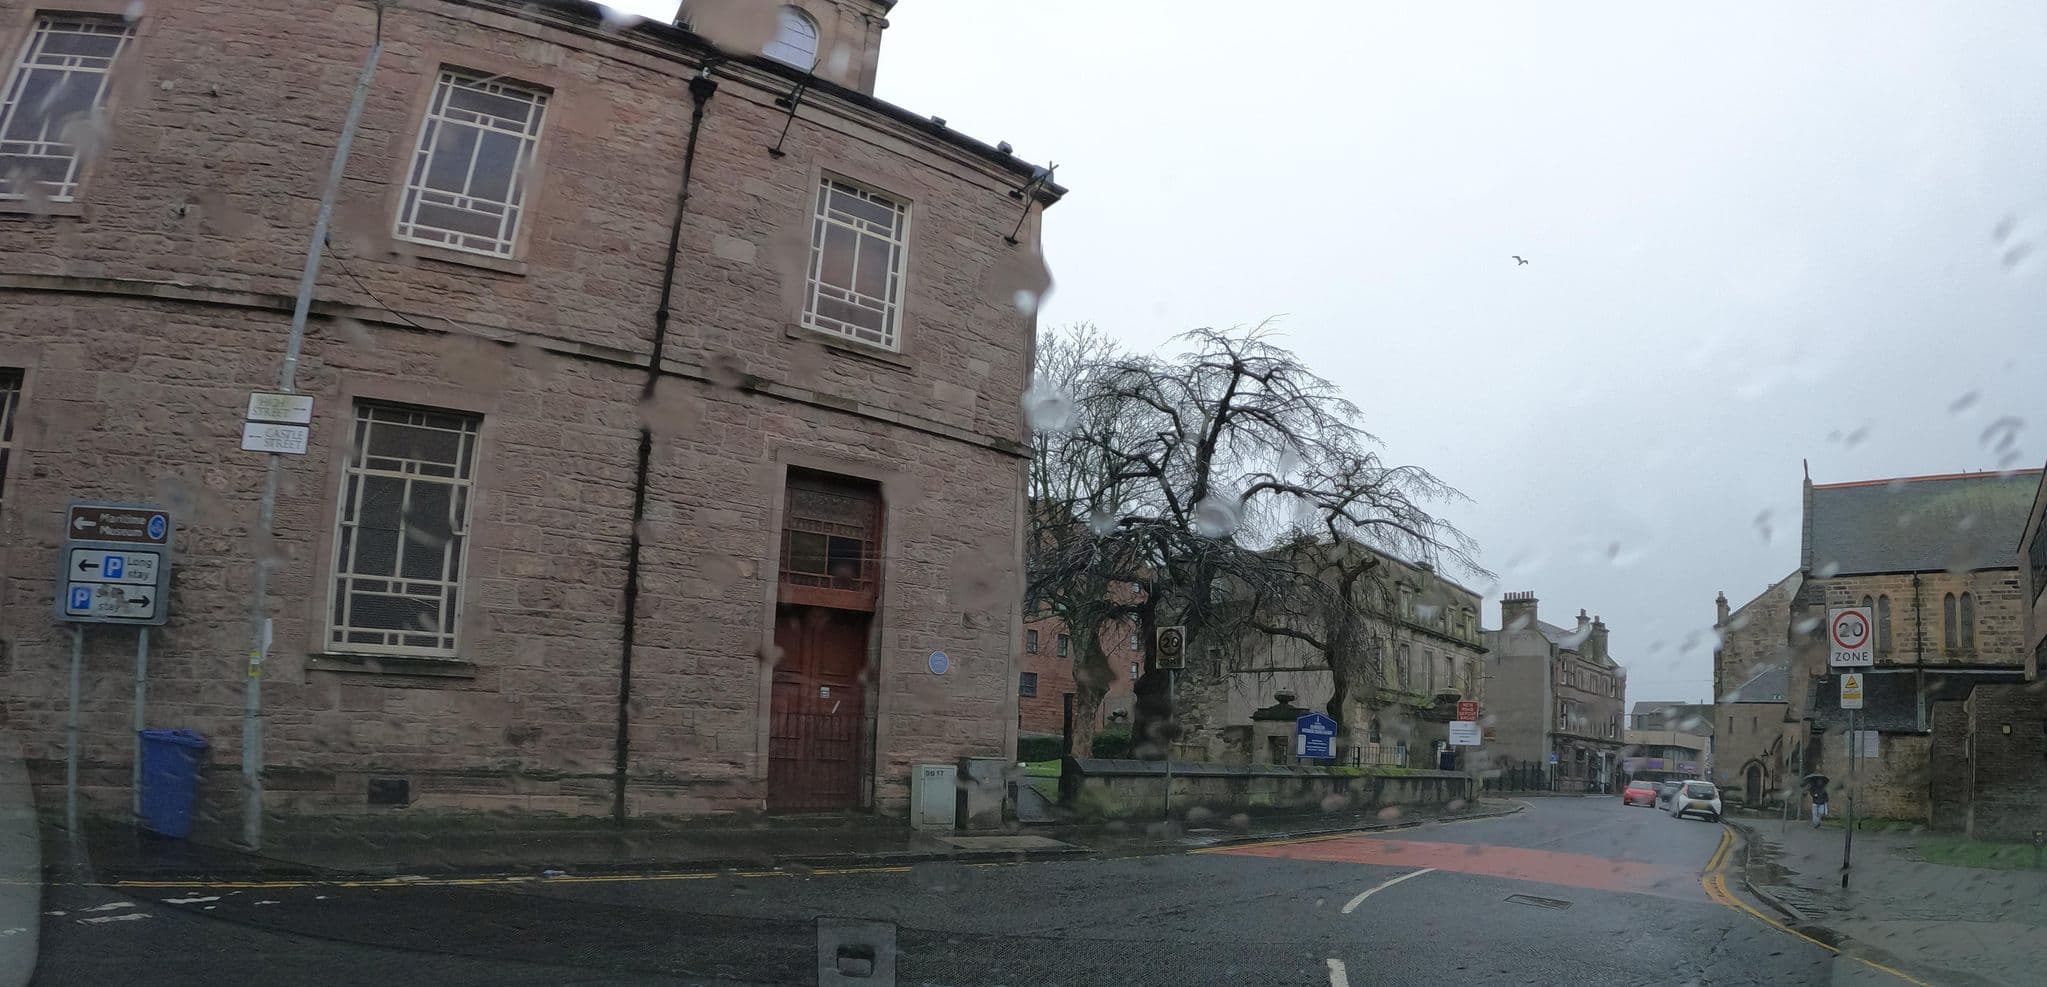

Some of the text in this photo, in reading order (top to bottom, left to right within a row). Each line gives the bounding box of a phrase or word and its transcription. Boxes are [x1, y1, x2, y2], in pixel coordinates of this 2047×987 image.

[251, 406, 289, 417] STREET
[264, 428, 303, 440] CASTLE
[263, 438, 303, 449] STREET
[99, 513, 147, 525] Maritime
[99, 525, 144, 537] Museum
[127, 556, 153, 569] Long
[127, 569, 149, 581] stay
[1838, 622, 1864, 638] 20
[1162, 636, 1179, 648] 20
[1835, 651, 1869, 662] ZONE
